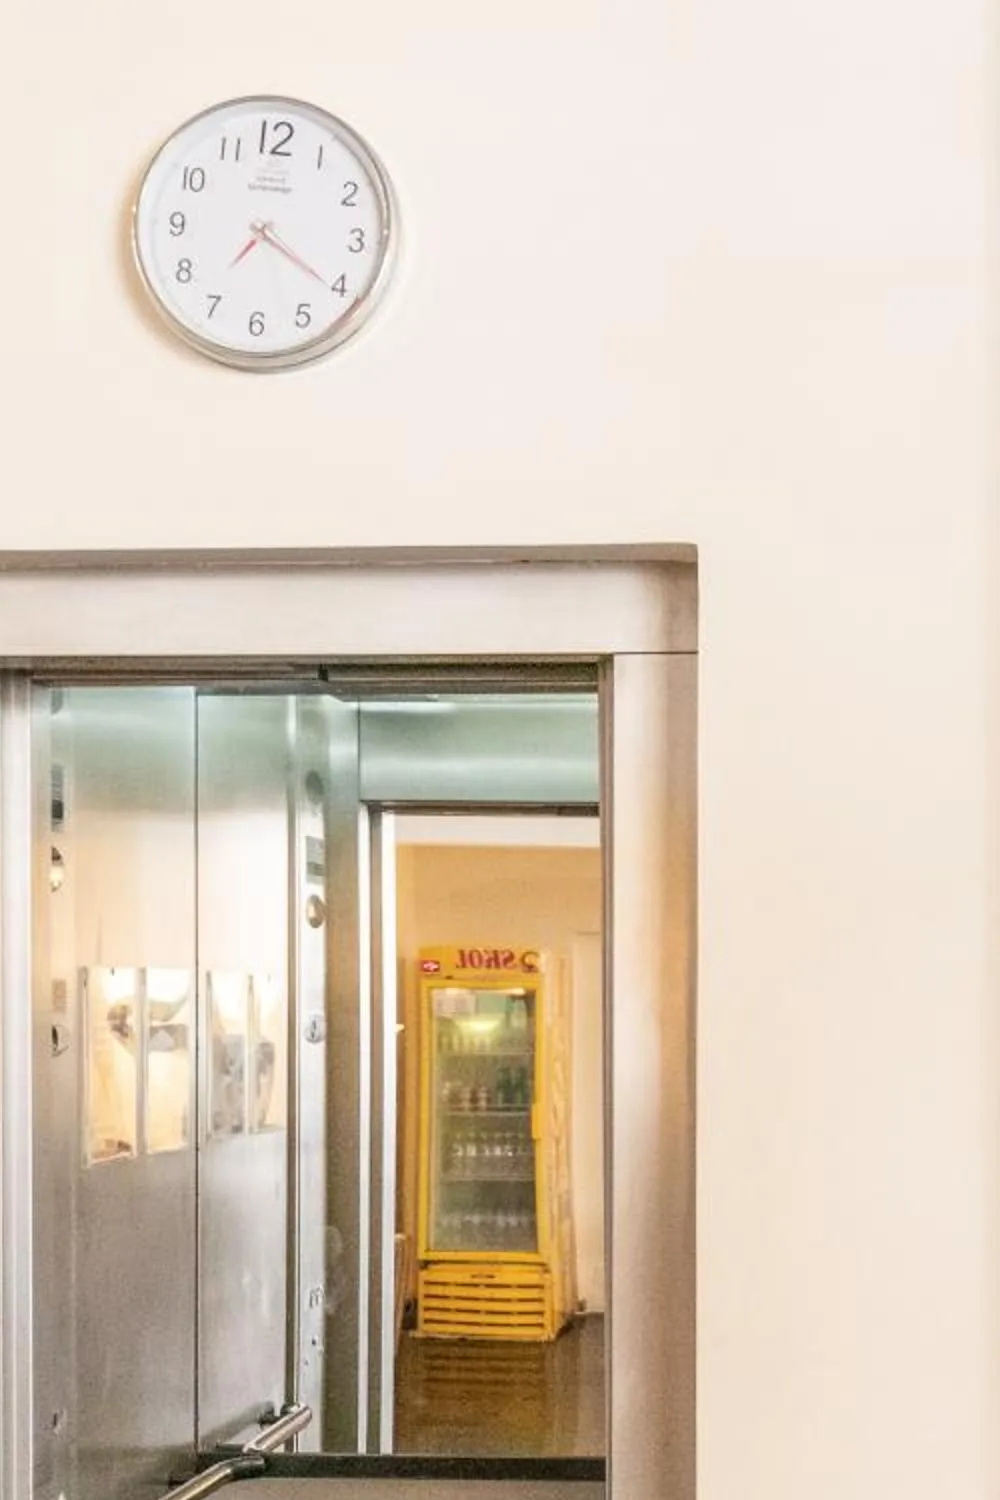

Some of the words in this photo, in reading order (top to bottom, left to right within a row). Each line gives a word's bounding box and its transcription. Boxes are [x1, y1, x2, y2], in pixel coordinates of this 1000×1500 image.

[219, 136, 241, 162] 11
[259, 119, 295, 157] 12
[316, 145, 323, 170] 1
[182, 165, 205, 193] 10
[340, 181, 359, 207] 2
[169, 211, 186, 237] 9
[347, 227, 365, 253] 3
[175, 258, 193, 284] 8
[330, 273, 348, 298] 4
[206, 294, 222, 320] 7
[294, 303, 311, 328] 5
[248, 311, 265, 336] 6
